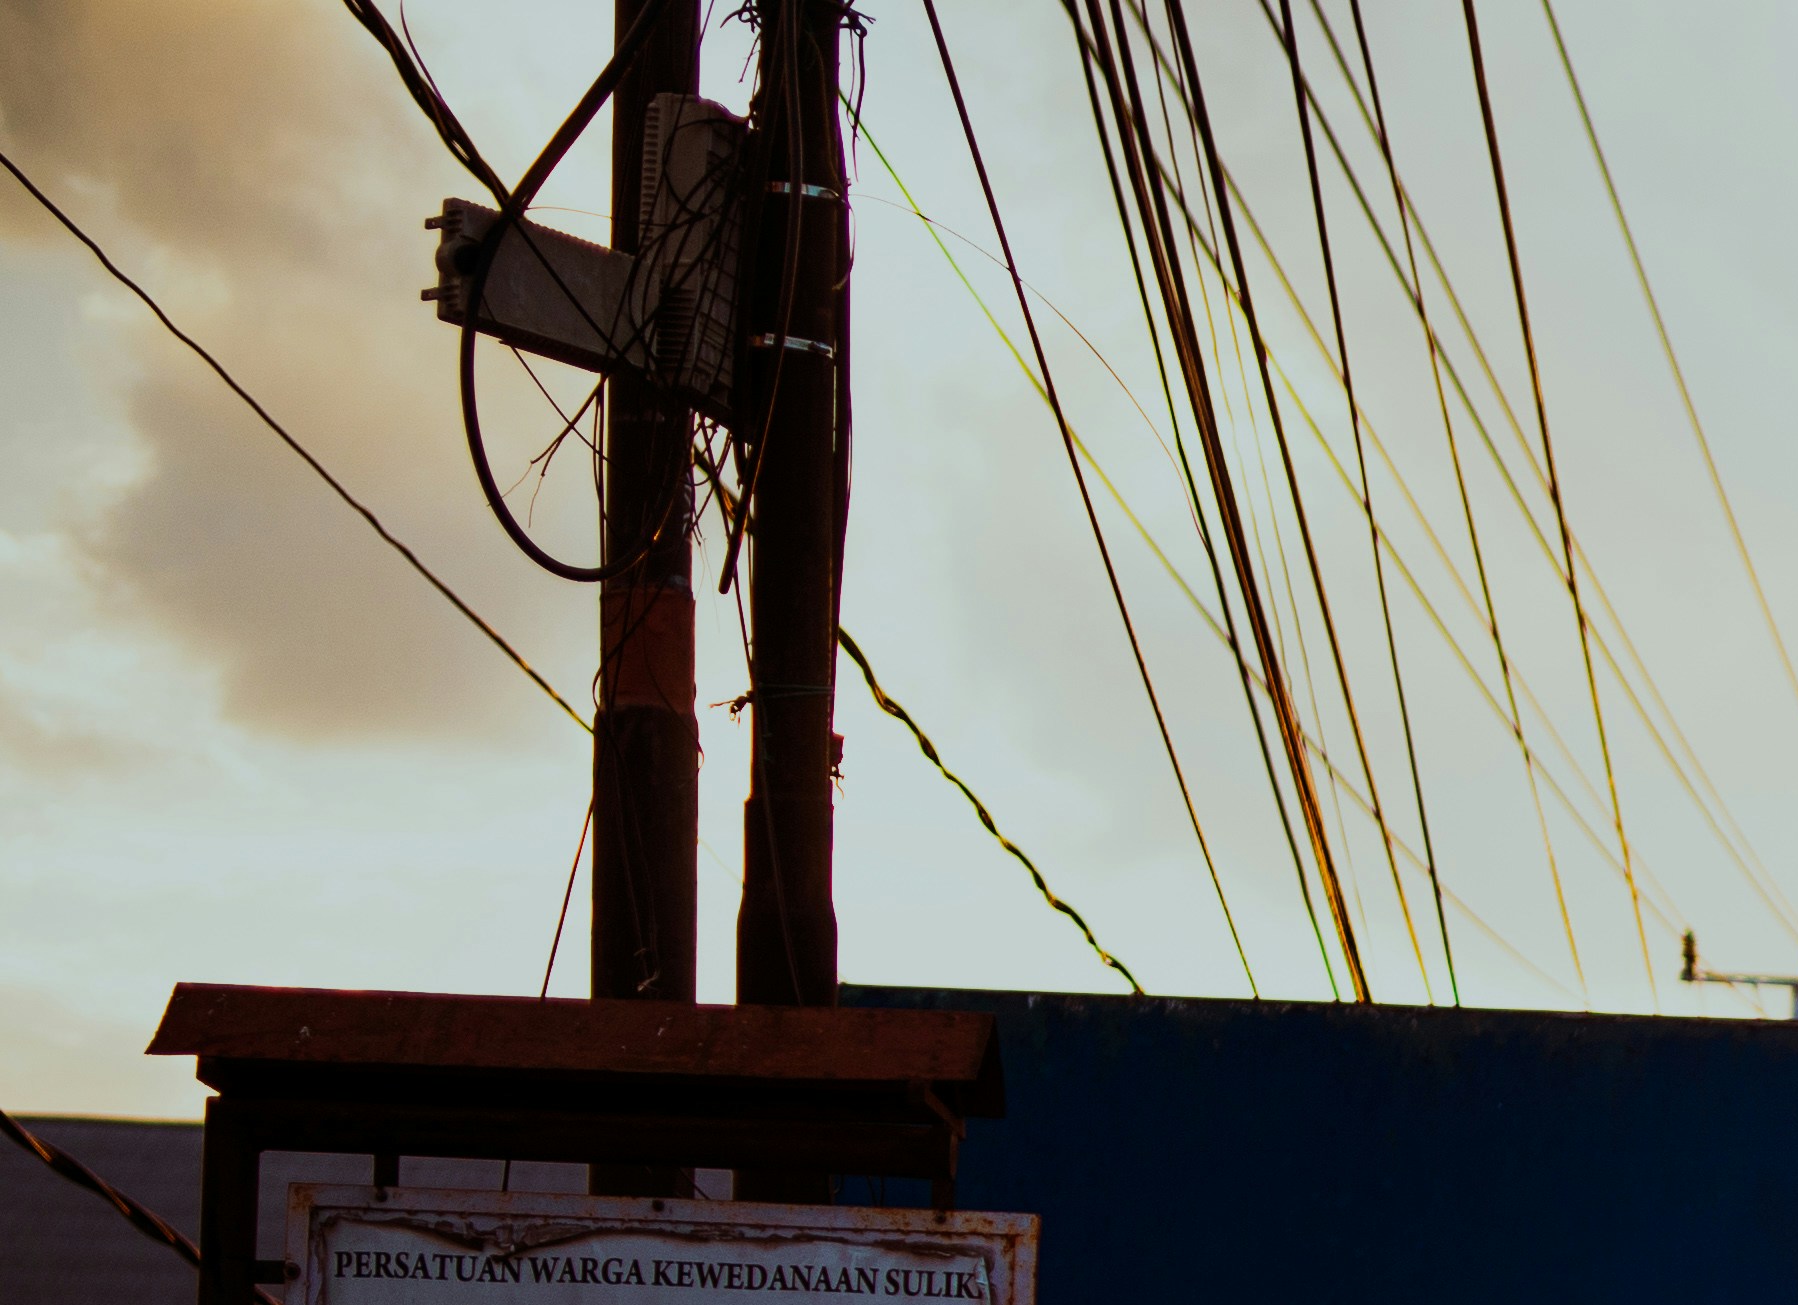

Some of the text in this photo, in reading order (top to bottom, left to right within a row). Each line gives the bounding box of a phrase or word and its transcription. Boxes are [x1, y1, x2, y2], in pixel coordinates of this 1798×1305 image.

[333, 1251, 983, 1299] PERSATUAN WARGA KEWEDANAAN SULIK
